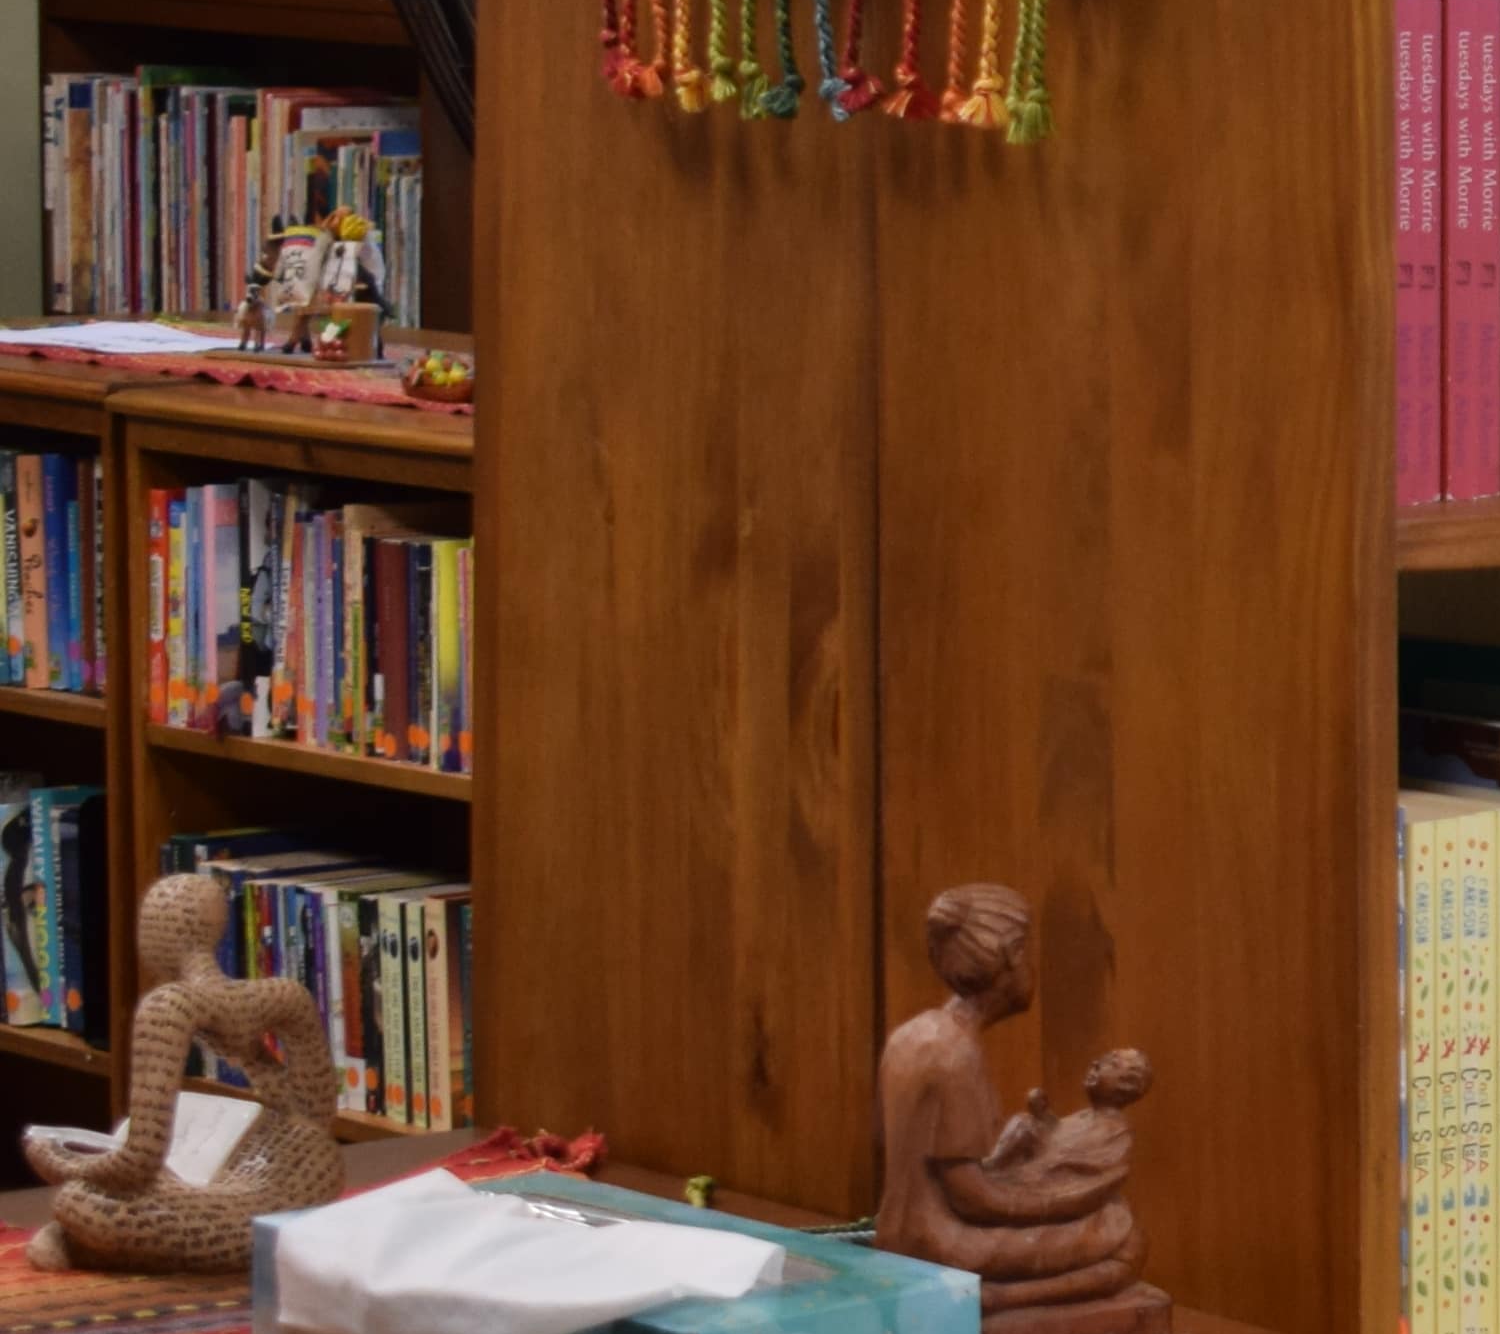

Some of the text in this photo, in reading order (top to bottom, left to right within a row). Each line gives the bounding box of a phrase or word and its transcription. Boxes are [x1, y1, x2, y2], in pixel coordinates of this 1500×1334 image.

[1482, 34, 1496, 232] tuesdays with Morrie
